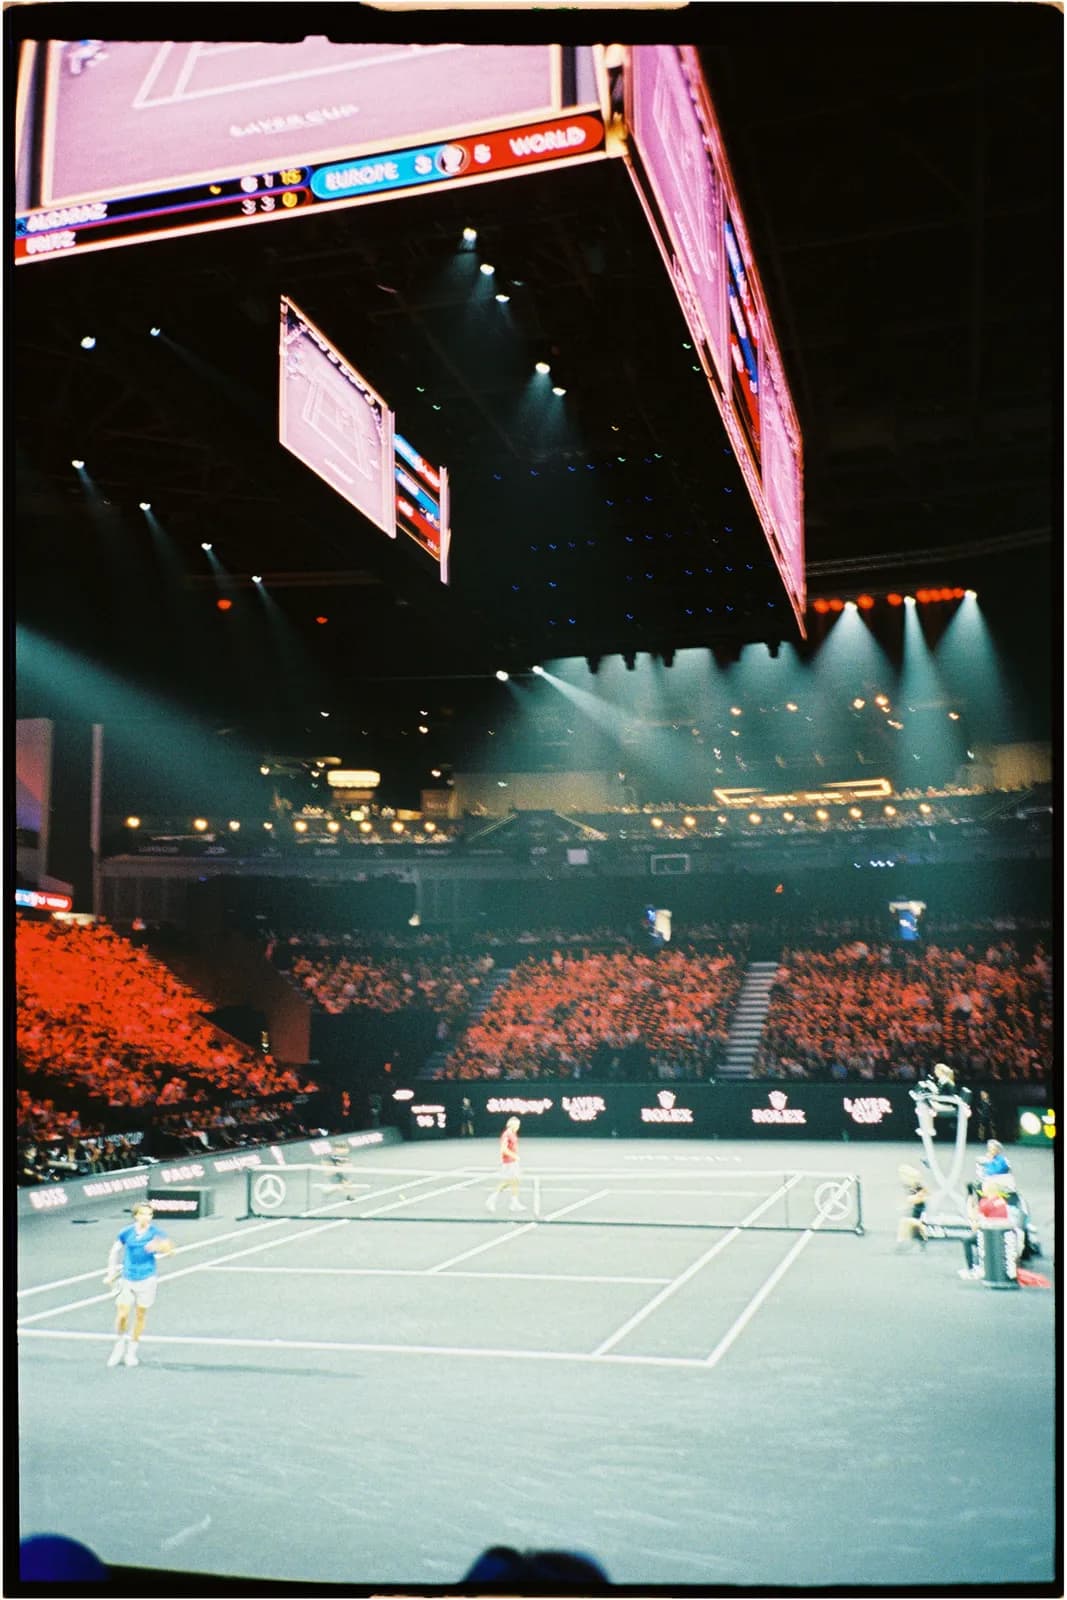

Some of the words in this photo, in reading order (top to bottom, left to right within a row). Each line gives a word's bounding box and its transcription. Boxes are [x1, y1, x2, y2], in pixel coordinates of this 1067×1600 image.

[509, 126, 586, 156] WORLD
[325, 162, 399, 190] EUROPE
[26, 203, 108, 232] ALCARAZ
[641, 1108, 694, 1123] ROLEX
[751, 1109, 807, 1124] ROLEX
[29, 1187, 69, 1209] BOSS
